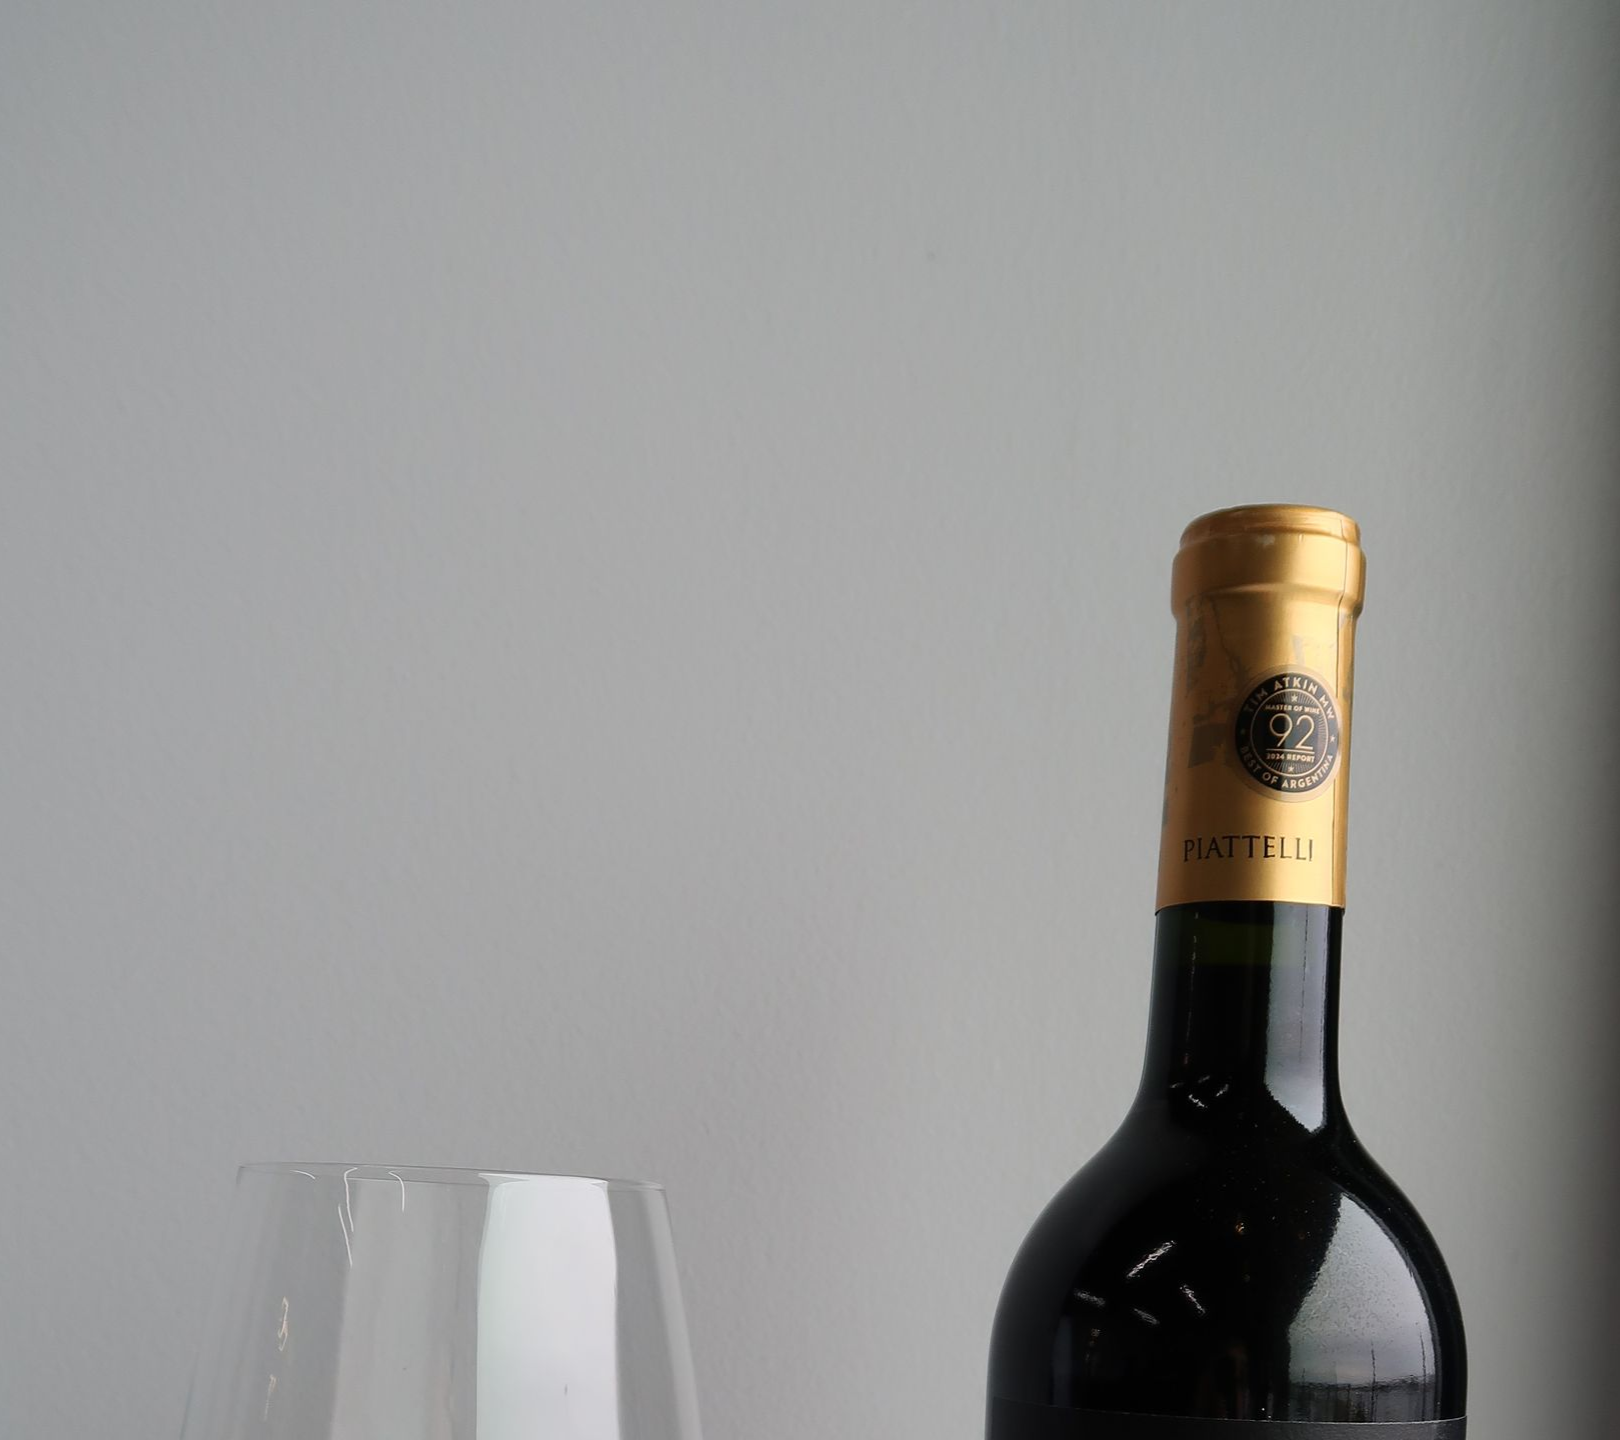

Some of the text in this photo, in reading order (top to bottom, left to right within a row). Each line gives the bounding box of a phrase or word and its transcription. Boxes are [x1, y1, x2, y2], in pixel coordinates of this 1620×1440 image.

[1243, 677, 1335, 720] TIM ATKIN MW
[1293, 704, 1303, 712] OF
[1304, 706, 1321, 714] WINE
[1269, 713, 1315, 751] 92
[1241, 745, 1333, 789] BEST OF ARGENTINA
[1266, 752, 1315, 763] 2024 REPORT
[1183, 835, 1313, 862] PIATTELLI
